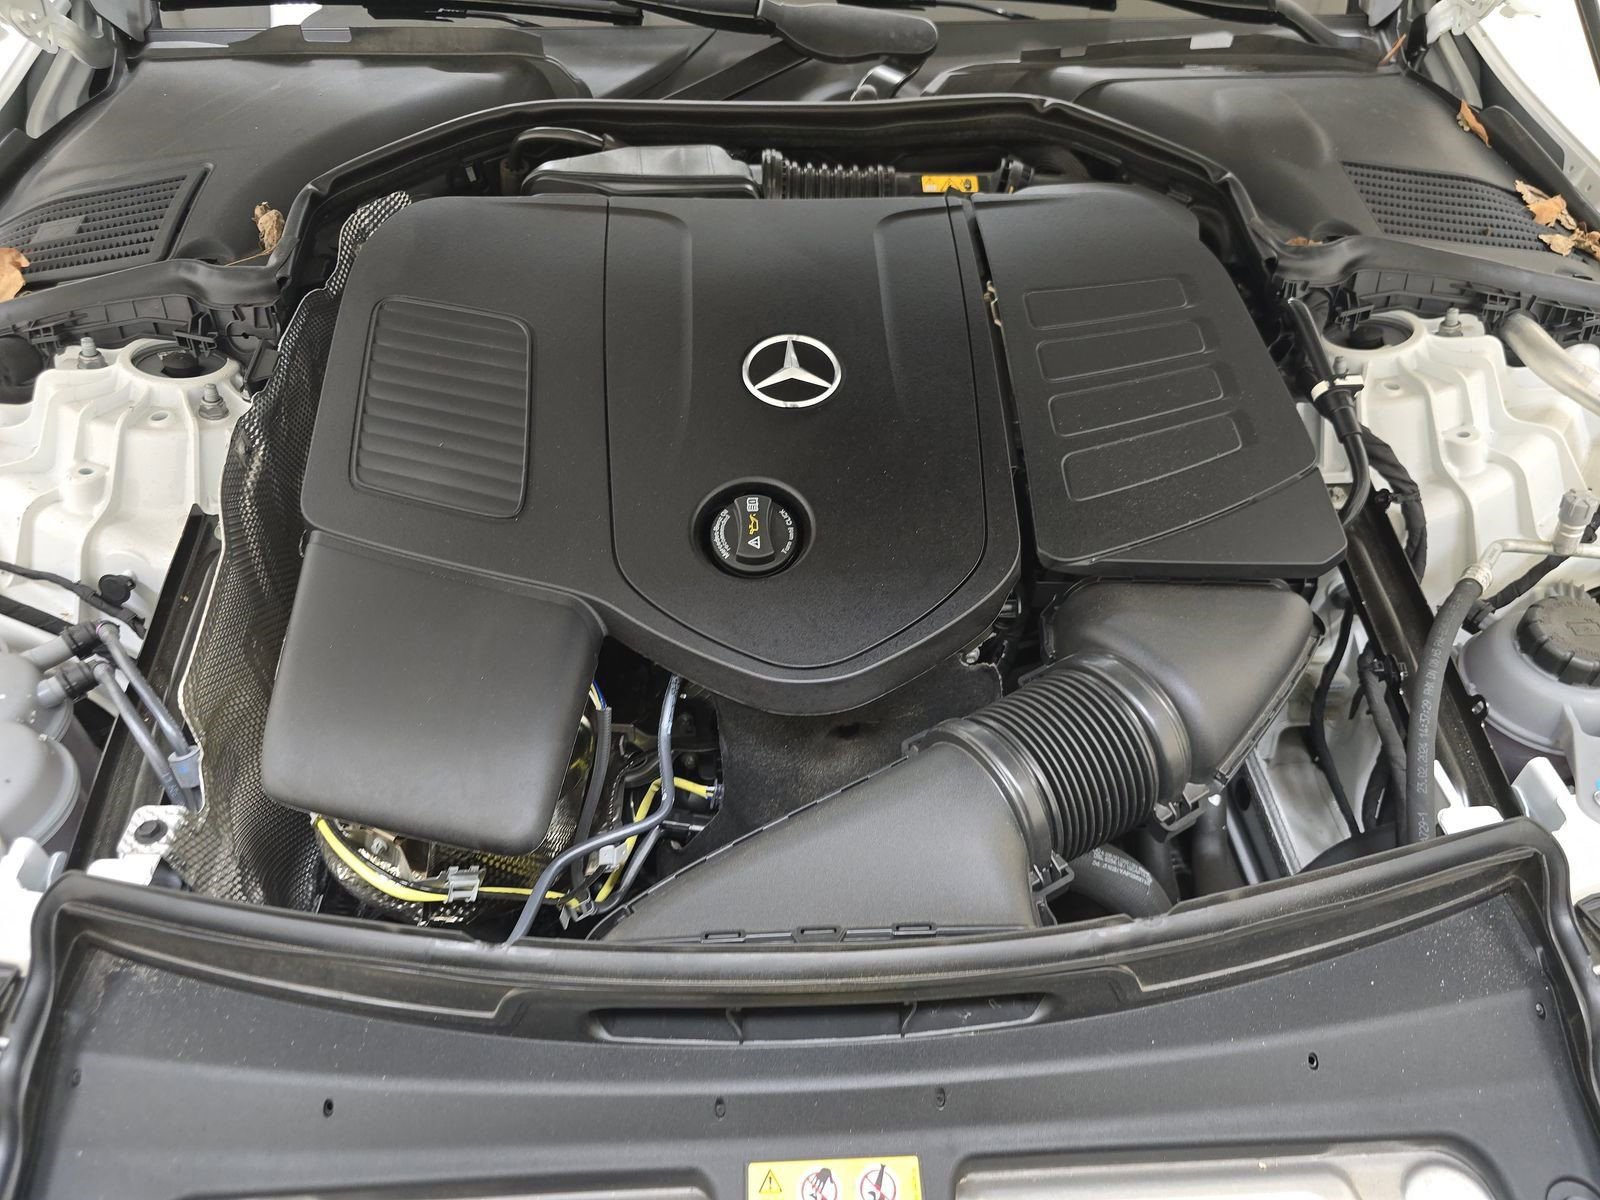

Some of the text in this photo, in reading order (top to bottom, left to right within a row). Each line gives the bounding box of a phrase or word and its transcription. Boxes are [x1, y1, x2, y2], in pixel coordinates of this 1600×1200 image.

[779, 509, 792, 526] CLICK
[781, 541, 792, 555] Turn
[1420, 699, 1432, 738] 14:37:29
